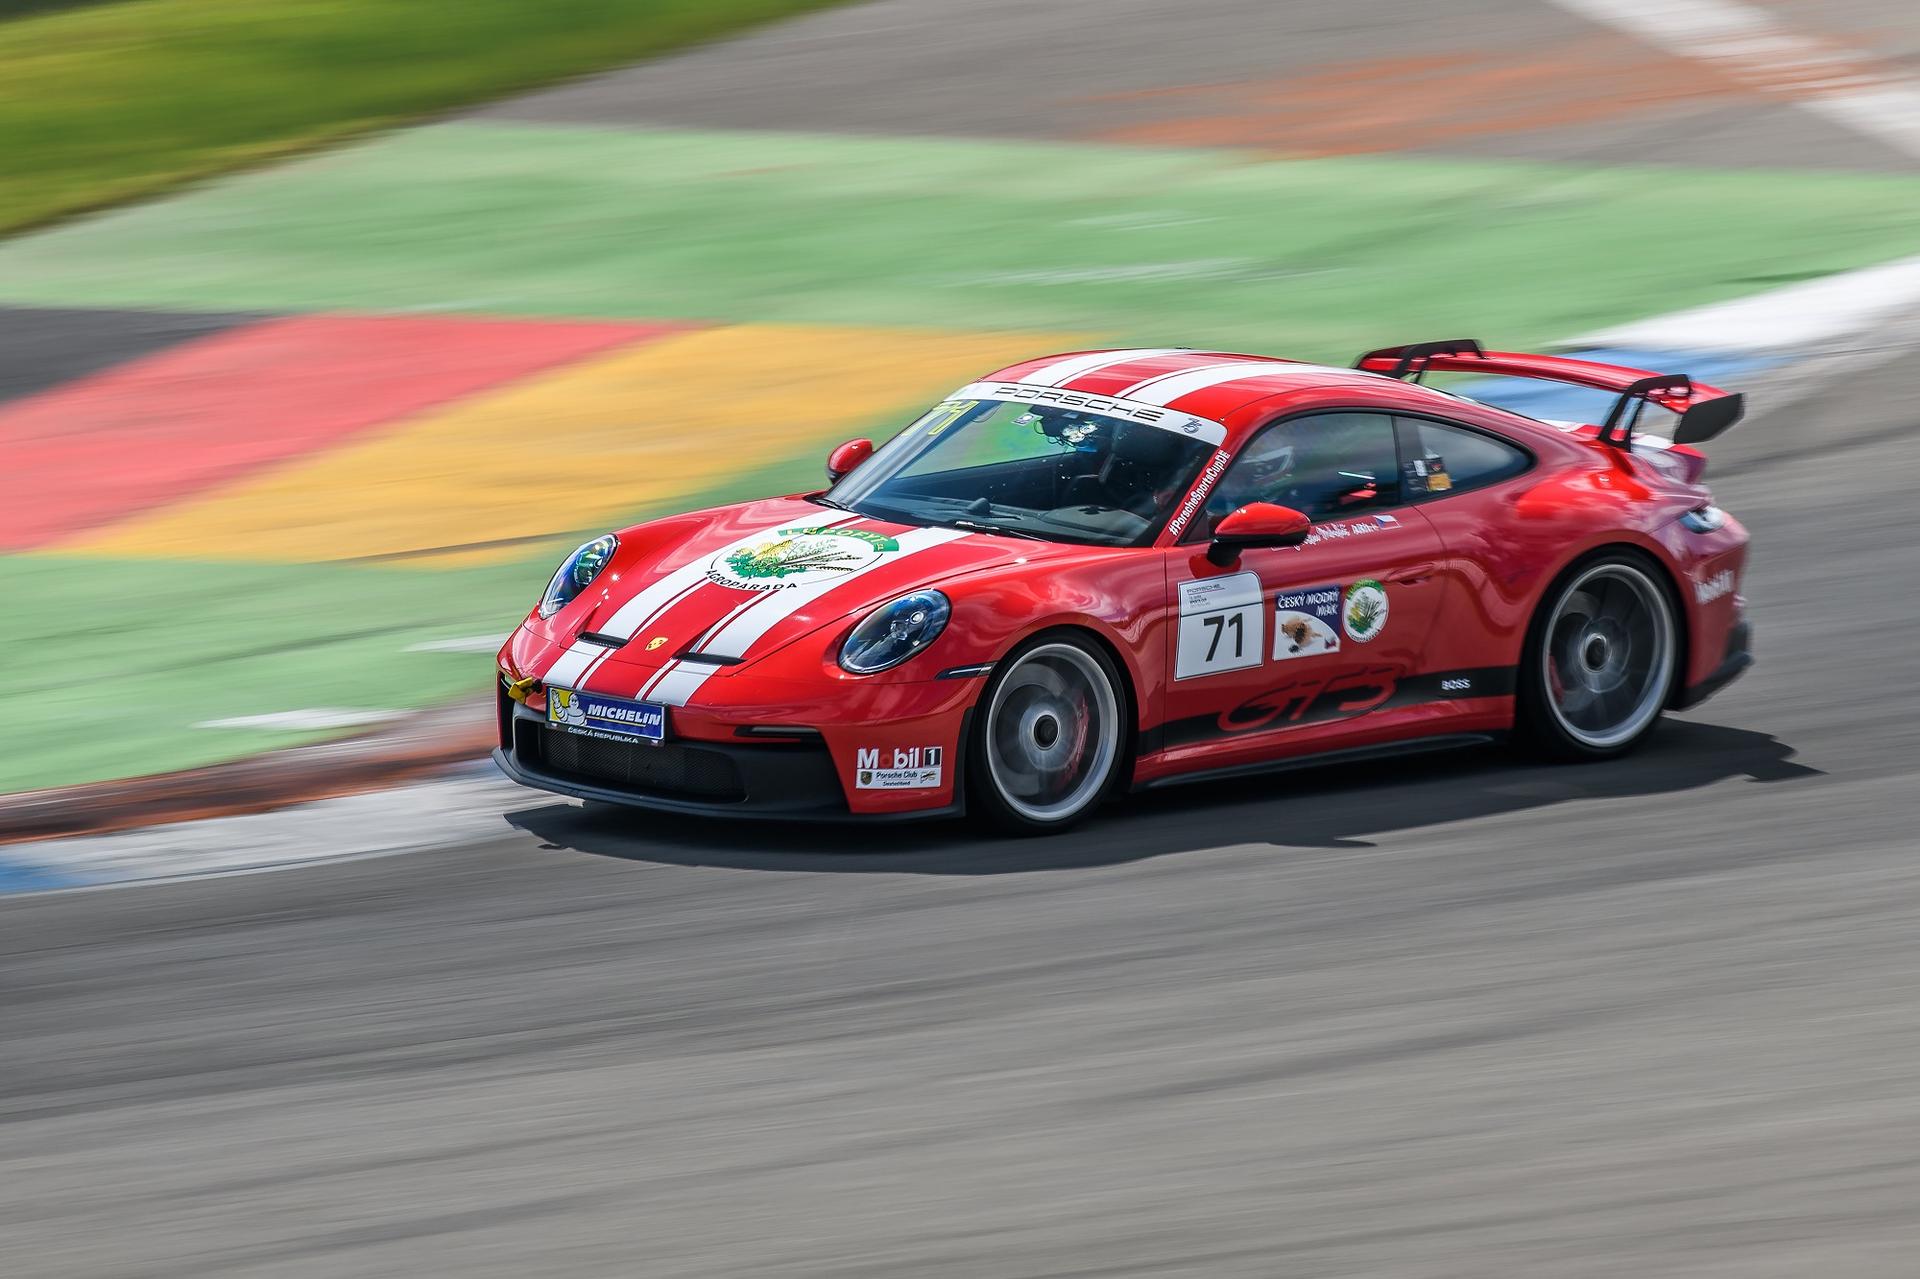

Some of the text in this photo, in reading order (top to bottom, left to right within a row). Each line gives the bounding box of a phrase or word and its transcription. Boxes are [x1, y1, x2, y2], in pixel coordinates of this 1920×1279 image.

[993, 386, 1166, 423] PORSCHE
[1168, 449, 1231, 537] #PorscheSportsCupDE
[704, 568, 799, 591] AGROPARADA
[1203, 612, 1243, 663] 71
[1217, 666, 1404, 732] GT3
[586, 703, 662, 727] MICHELIN
[857, 747, 920, 769] Mobil
[875, 770, 918, 780] Porsche Club
